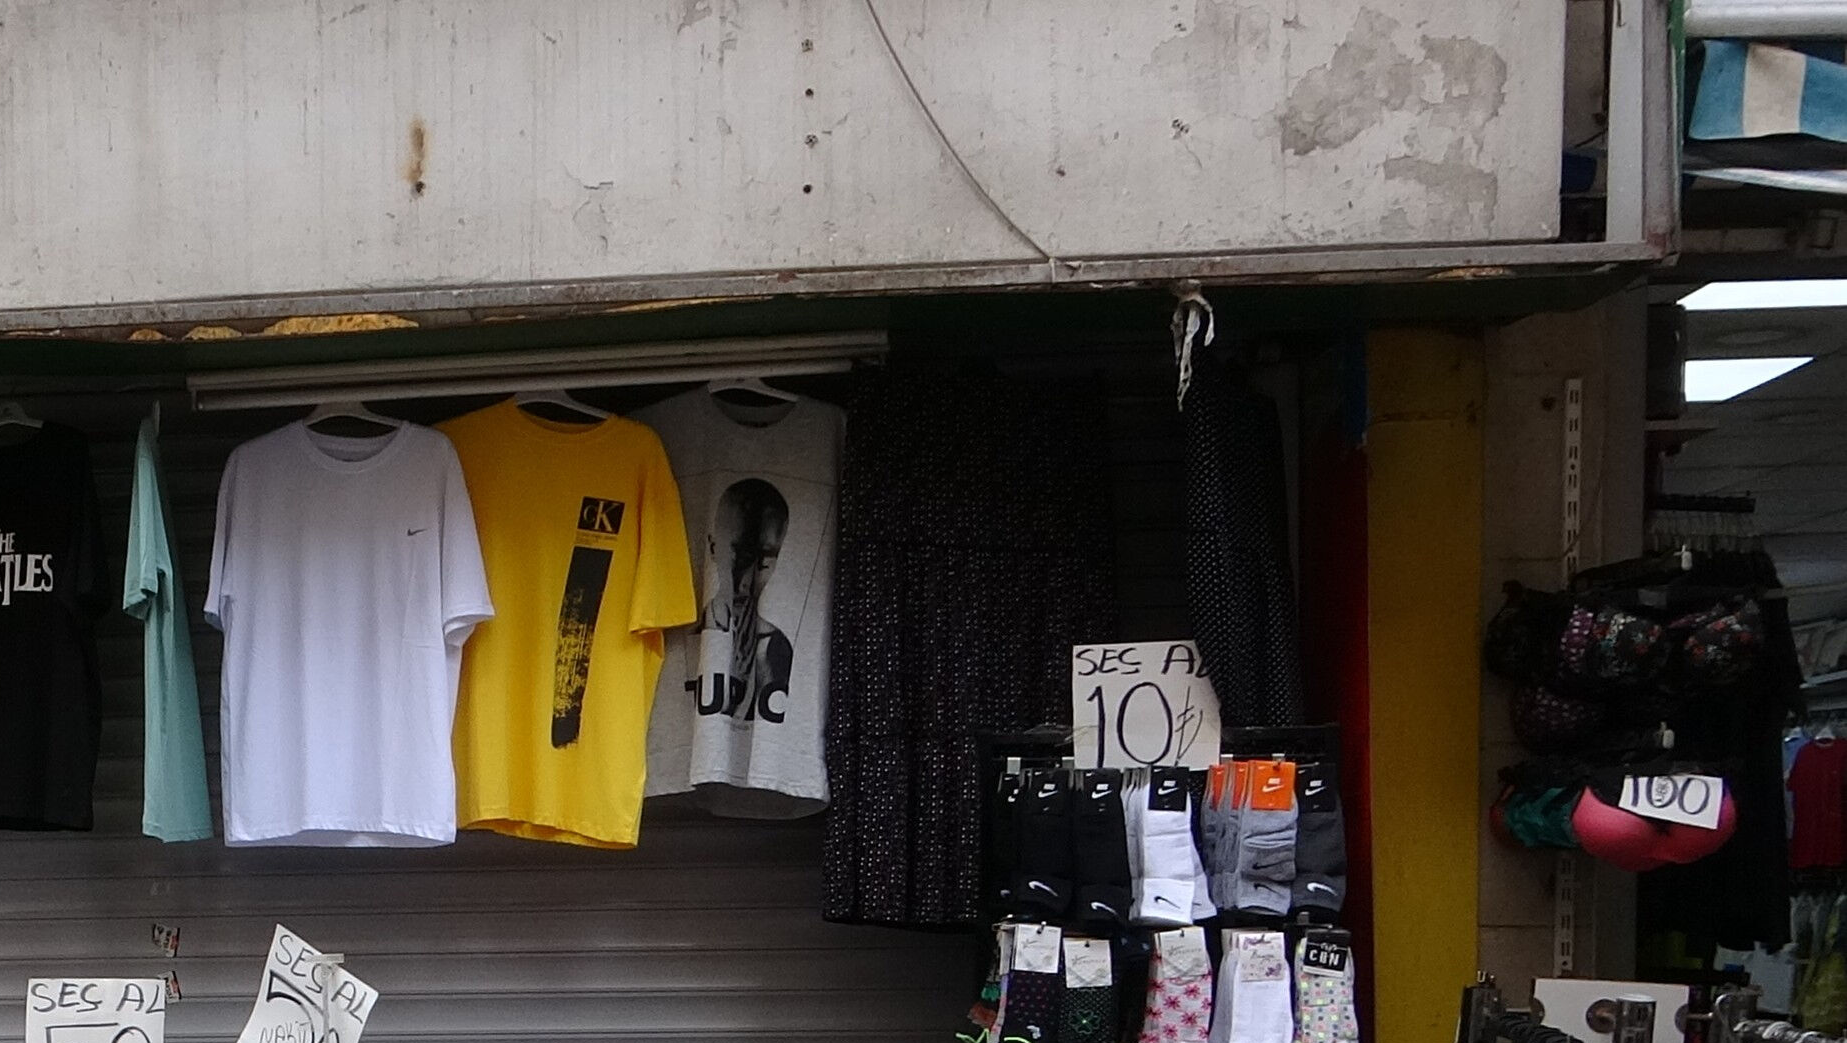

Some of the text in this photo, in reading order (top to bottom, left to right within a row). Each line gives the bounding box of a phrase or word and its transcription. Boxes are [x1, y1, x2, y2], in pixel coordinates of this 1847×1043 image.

[1631, 776, 1710, 815] 100
[116, 983, 166, 1014] AL
[331, 980, 368, 1025] AL
